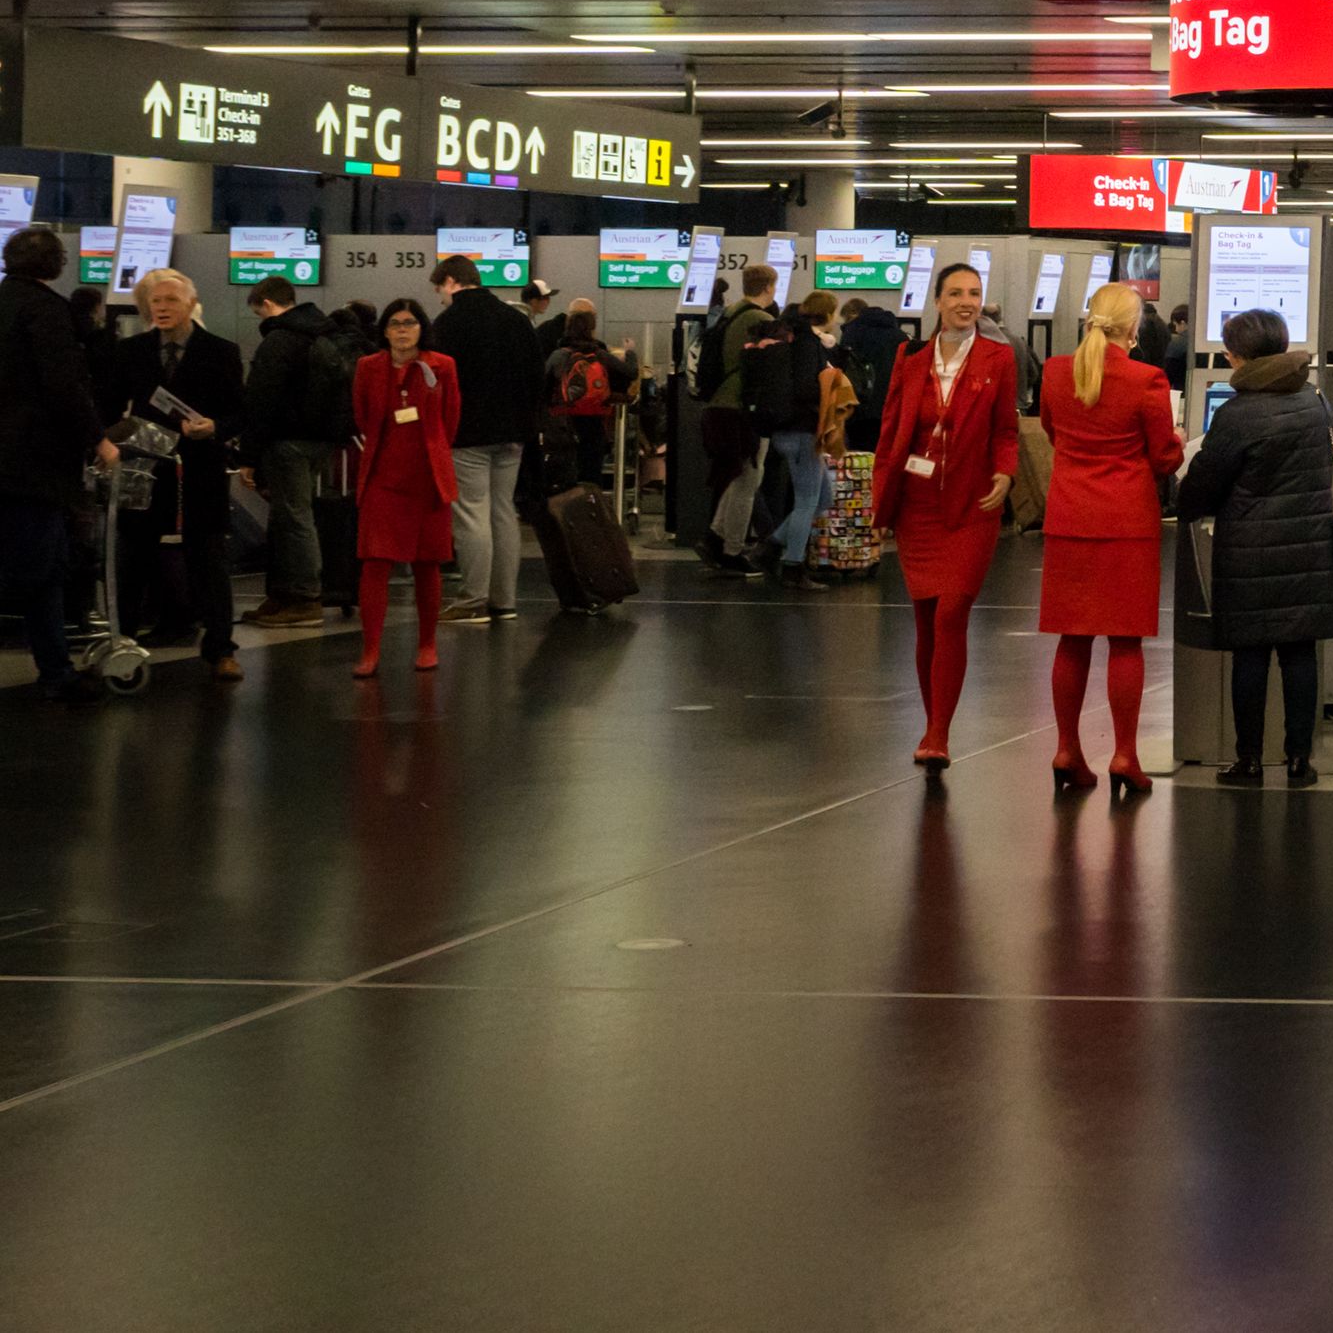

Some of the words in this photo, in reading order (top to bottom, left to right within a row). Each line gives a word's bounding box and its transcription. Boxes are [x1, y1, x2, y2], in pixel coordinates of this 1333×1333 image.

[1209, 9, 1270, 55] Tag
[218, 88, 262, 107] Terminal
[347, 84, 371, 99] Gates
[217, 107, 261, 125] Check-in
[1094, 175, 1149, 191] Check-in
[1186, 175, 1226, 198] Austrian
[1094, 194, 1105, 206] &
[1109, 193, 1134, 211] Bag
[1137, 194, 1154, 212] Tag
[826, 234, 868, 244] Austrian
[346, 251, 378, 268] 354
[395, 251, 426, 268] 353
[608, 264, 624, 272] Self
[625, 264, 659, 274] Baggage
[825, 265, 841, 274] Self
[841, 265, 876, 275] Baggage
[608, 274, 627, 284] Drop
[824, 276, 844, 285] Drop
[845, 276, 856, 284] off
